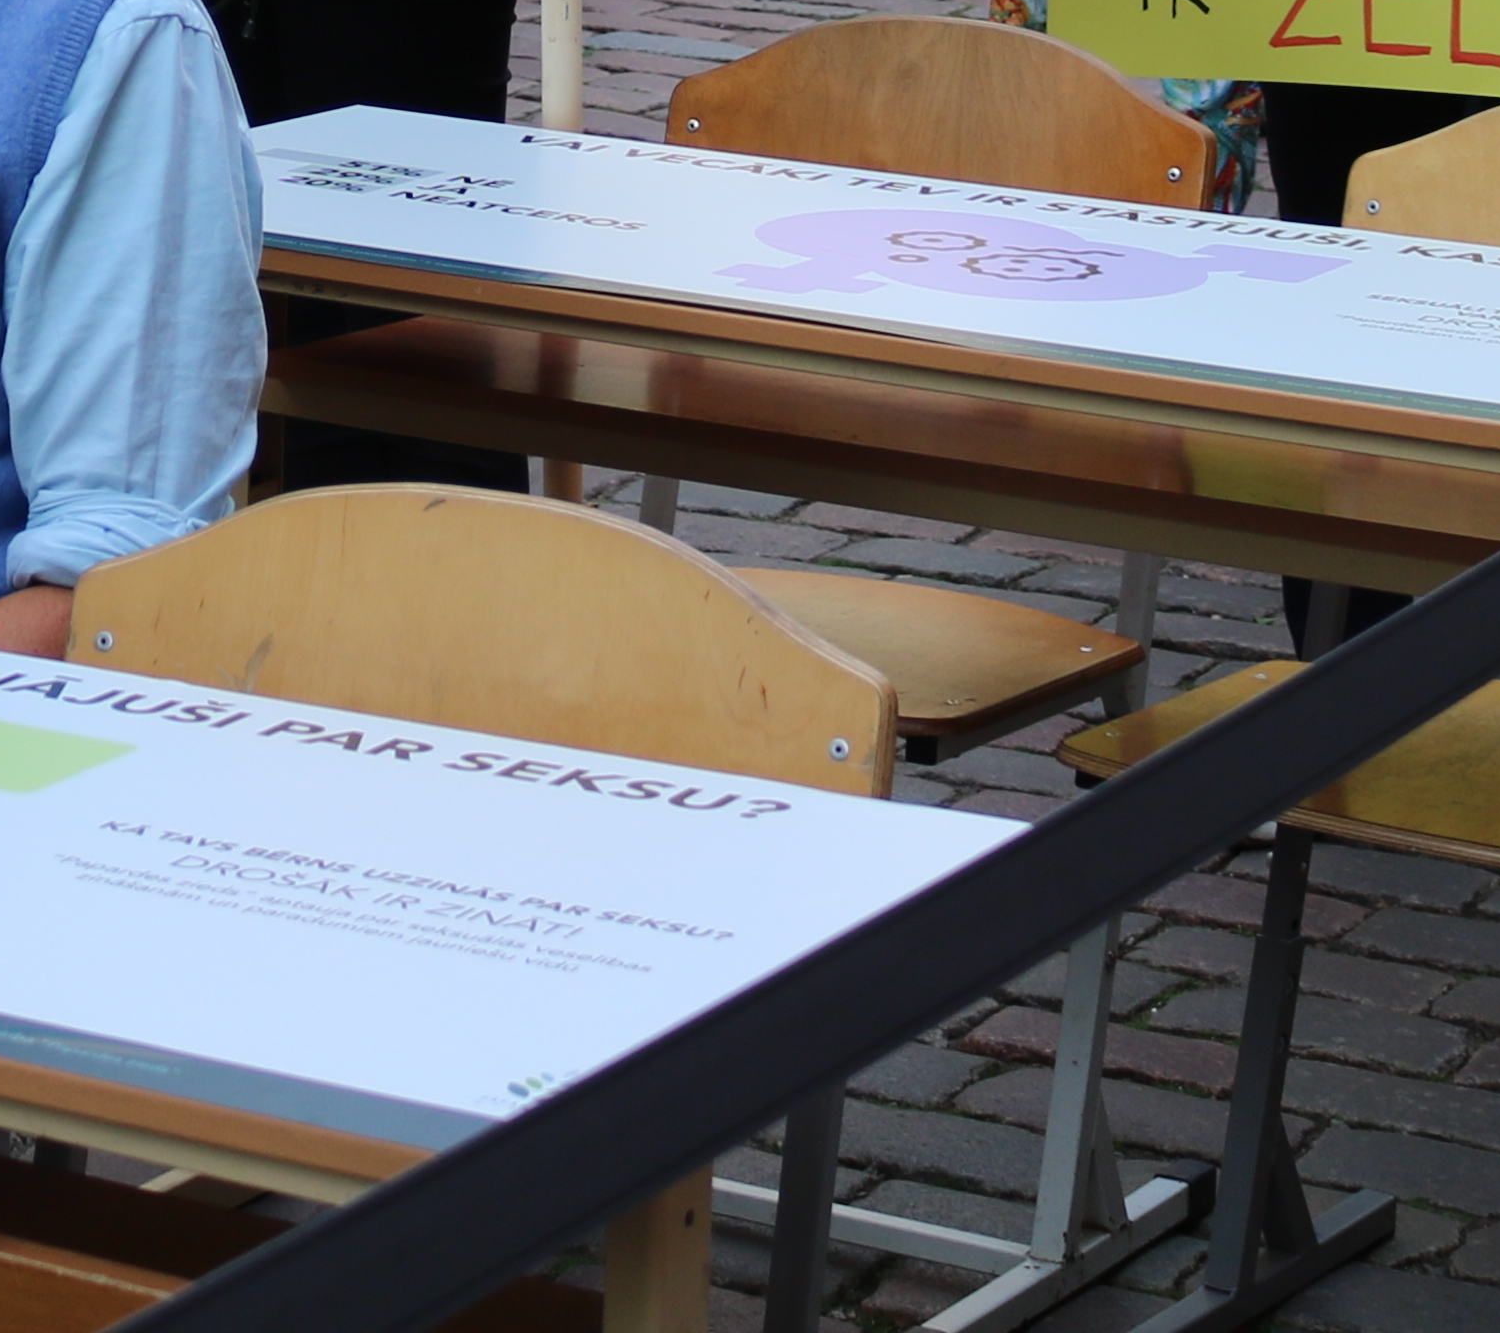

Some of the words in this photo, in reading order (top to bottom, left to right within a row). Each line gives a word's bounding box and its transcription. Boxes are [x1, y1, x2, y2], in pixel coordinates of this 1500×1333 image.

[282, 176, 363, 192] 20%
[389, 190, 649, 231] NEATCEROS
[309, 168, 392, 184] 29%
[339, 161, 422, 177] 51%
[448, 175, 512, 187] NĒ
[519, 134, 609, 153] VAI
[625, 148, 833, 181] VECĀKI
[848, 177, 958, 195] TEV
[966, 193, 1027, 206] IR
[1037, 202, 1369, 251] STĀSTĪJUŠI,
[259, 720, 434, 761] PAR
[444, 753, 791, 818] SEKSU?
[100, 821, 146, 836] KĀ
[159, 831, 237, 851] TAVS
[242, 847, 355, 873] BĒRNS
[362, 868, 514, 902] UZZINĀS
[520, 897, 590, 916] PAR
[596, 911, 734, 941] SEKSU?
[170, 855, 368, 900] DROŠĀK
[372, 892, 421, 910] IR
[424, 901, 584, 939] ZINĀT!
